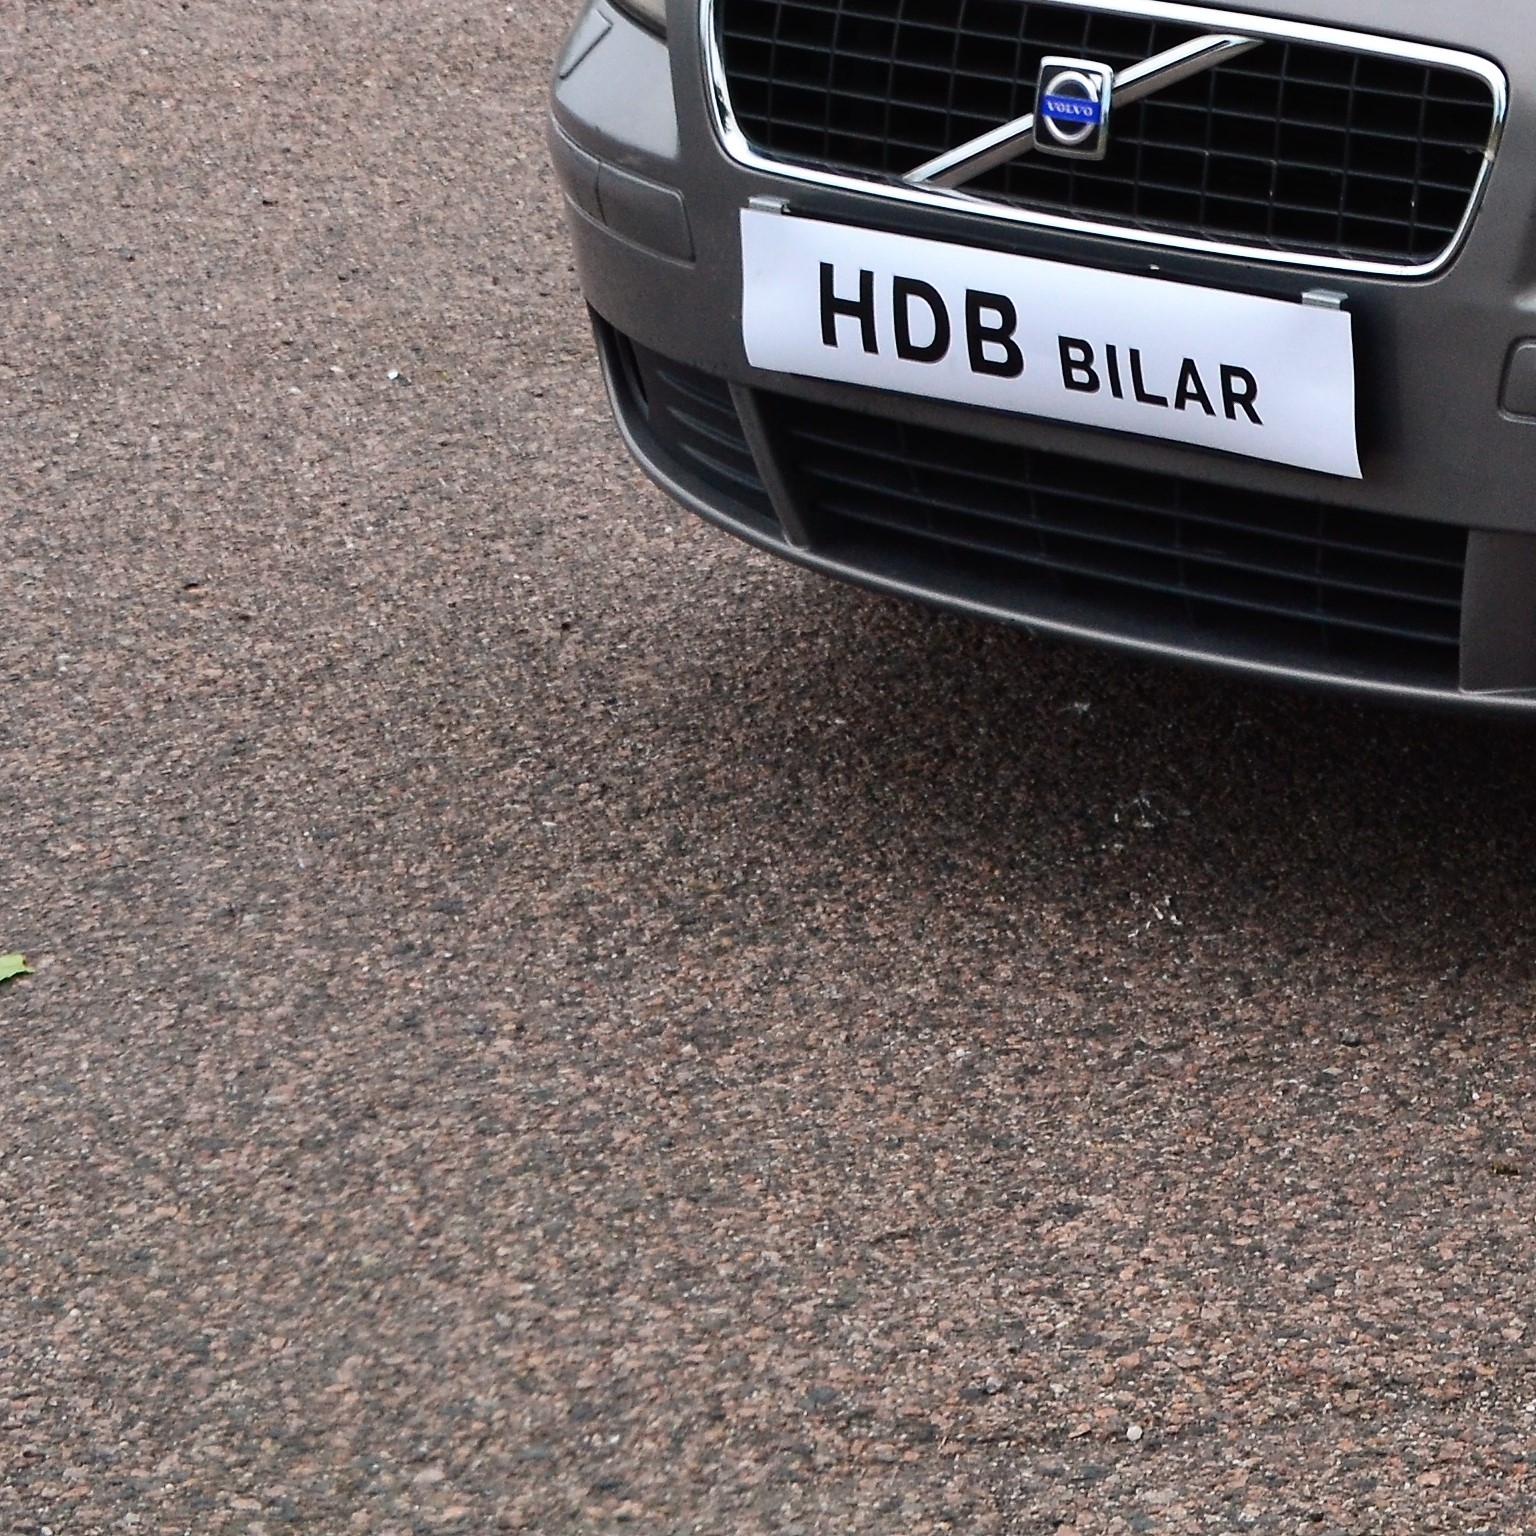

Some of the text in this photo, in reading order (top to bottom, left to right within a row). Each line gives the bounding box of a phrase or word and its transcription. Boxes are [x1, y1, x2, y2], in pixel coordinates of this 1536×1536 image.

[1047, 100, 1093, 117] VOLVO
[818, 261, 1264, 427] HDB BILAR
